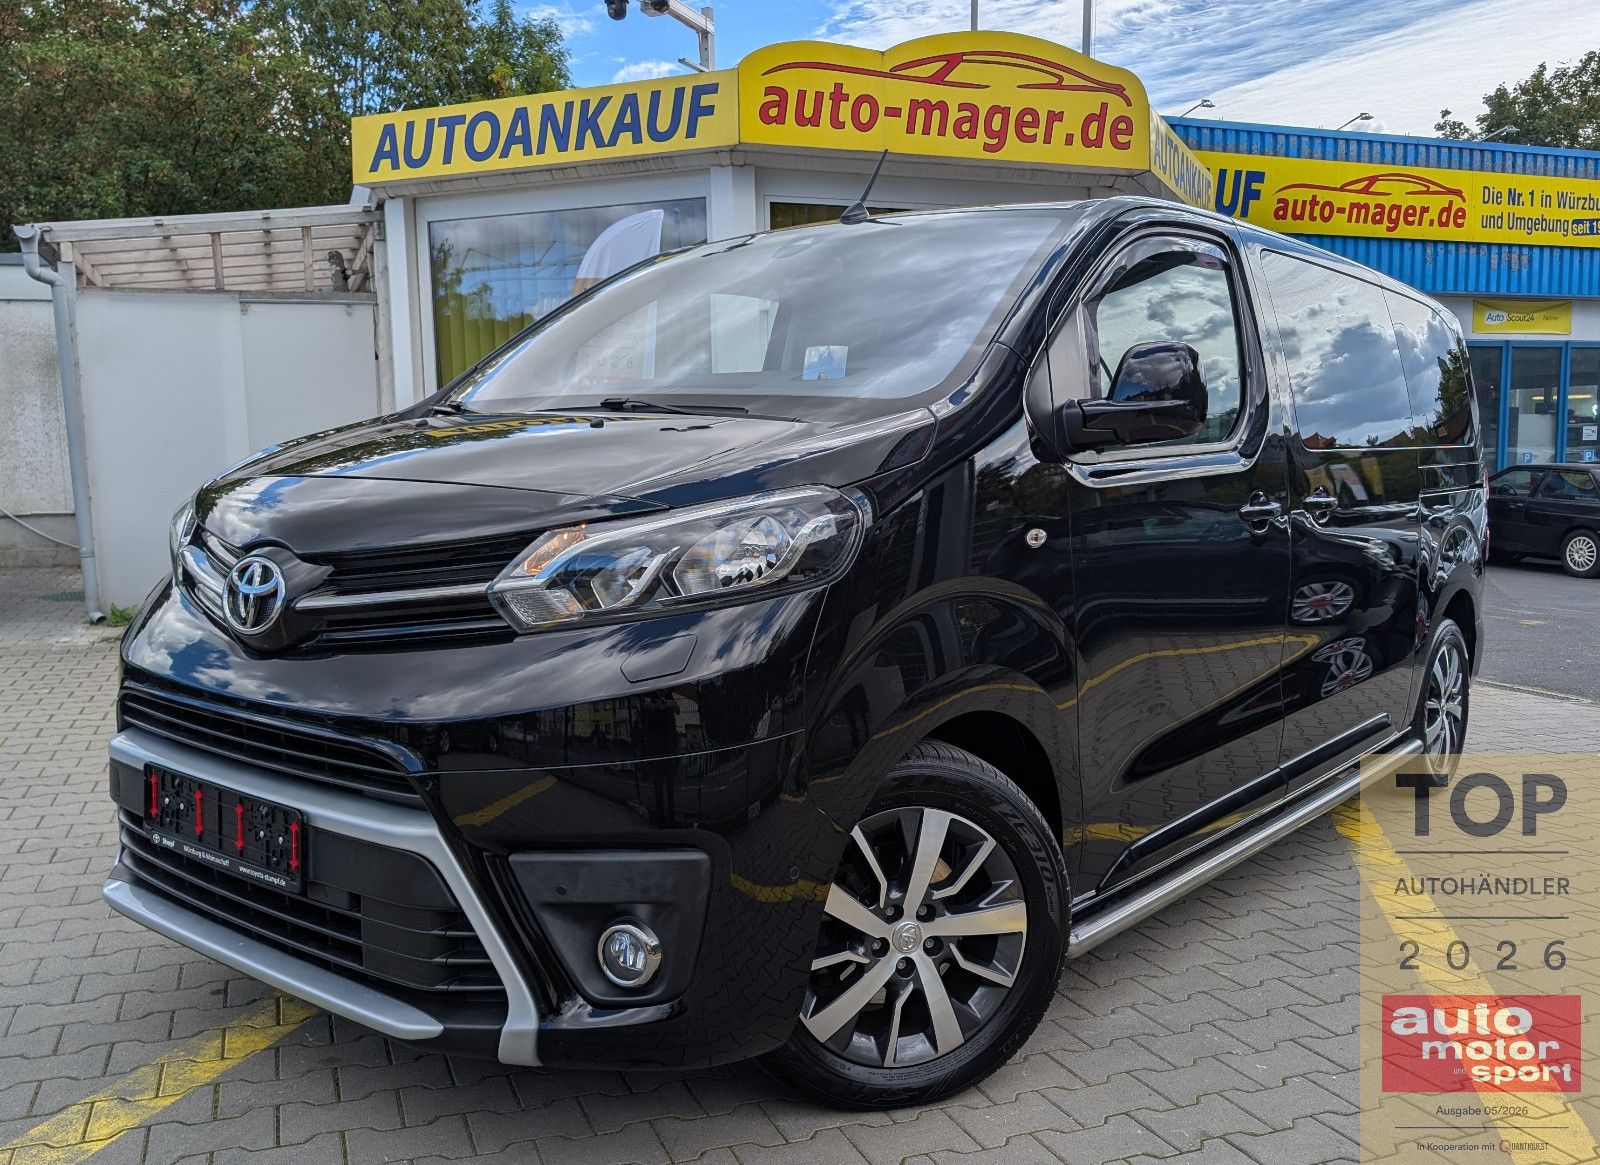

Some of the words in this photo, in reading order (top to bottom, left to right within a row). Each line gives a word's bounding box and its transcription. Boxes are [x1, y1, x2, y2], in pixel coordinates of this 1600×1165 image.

[369, 82, 719, 173] AUTOANKAUF
[758, 82, 1134, 153] auto-mager.de
[1154, 122, 1212, 209] AUTOANKAUF
[1214, 168, 1265, 218] UF
[1273, 195, 1467, 232] auto-mager.de
[1482, 186, 1503, 205] Die
[1507, 188, 1525, 207] Nr.
[1529, 189, 1535, 207] 1
[1540, 190, 1552, 208] in
[1481, 212, 1503, 229] und
[1507, 212, 1569, 237] Umgebung
[1572, 220, 1590, 235] seit
[1486, 312, 1504, 322] Auto
[1506, 313, 1535, 322] Scout24
